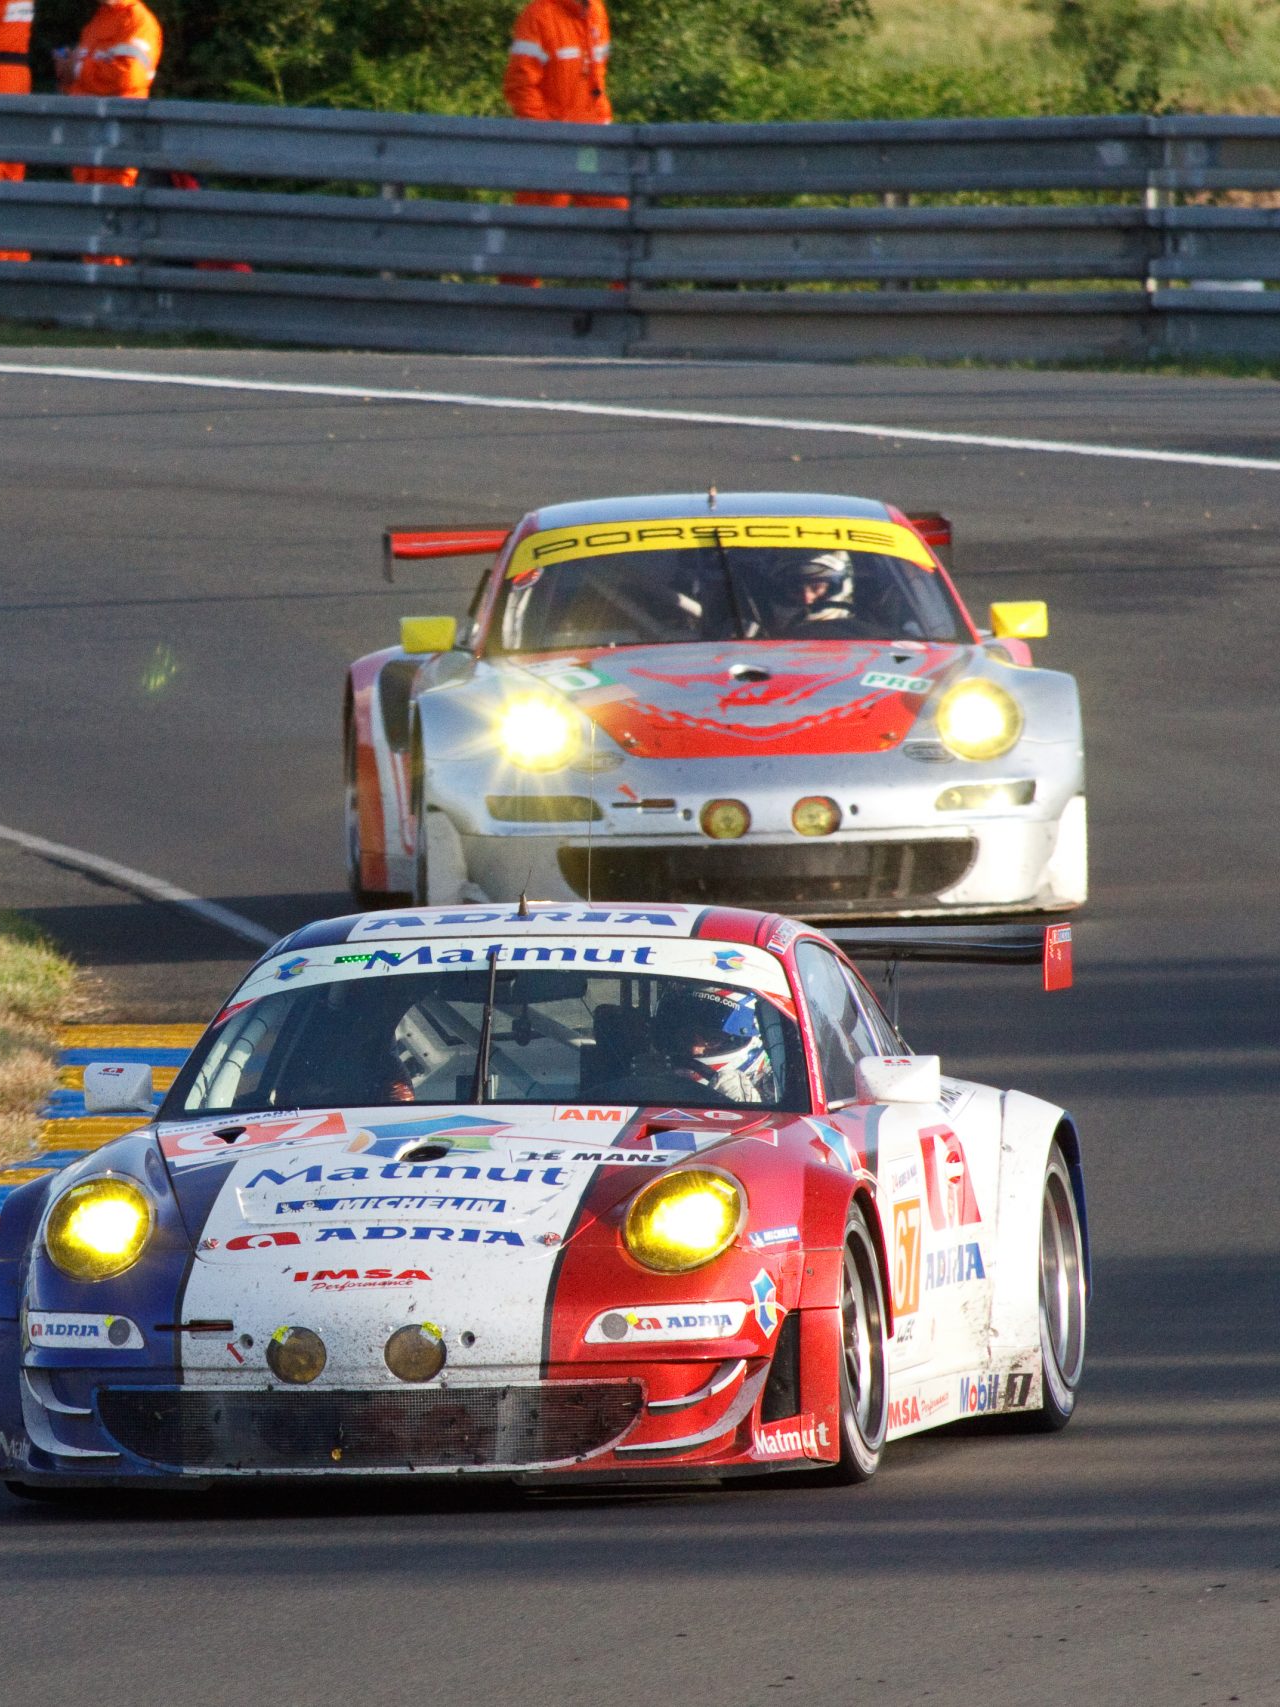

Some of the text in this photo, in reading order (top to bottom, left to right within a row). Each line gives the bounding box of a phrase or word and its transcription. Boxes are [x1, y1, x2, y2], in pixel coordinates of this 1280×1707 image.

[532, 524, 896, 560] PORSCHE
[867, 674, 928, 692] PRO
[363, 911, 679, 932] ADRIA
[363, 943, 657, 971] Matmut
[558, 1108, 622, 1121] AM
[176, 1114, 329, 1151] 67
[571, 1152, 669, 1163] MANS
[245, 1163, 569, 1189] Matmut
[335, 1197, 500, 1213] MICHELIN
[314, 1226, 525, 1247] ADRIA
[893, 1206, 920, 1311] 67
[293, 1268, 433, 1282] IMSA
[44, 1323, 100, 1338] ADRIA
[666, 1312, 733, 1329] ADRIA
[960, 1373, 1000, 1414] Mobil
[887, 1395, 921, 1430] MSA
[754, 1421, 832, 1456] Matmut
